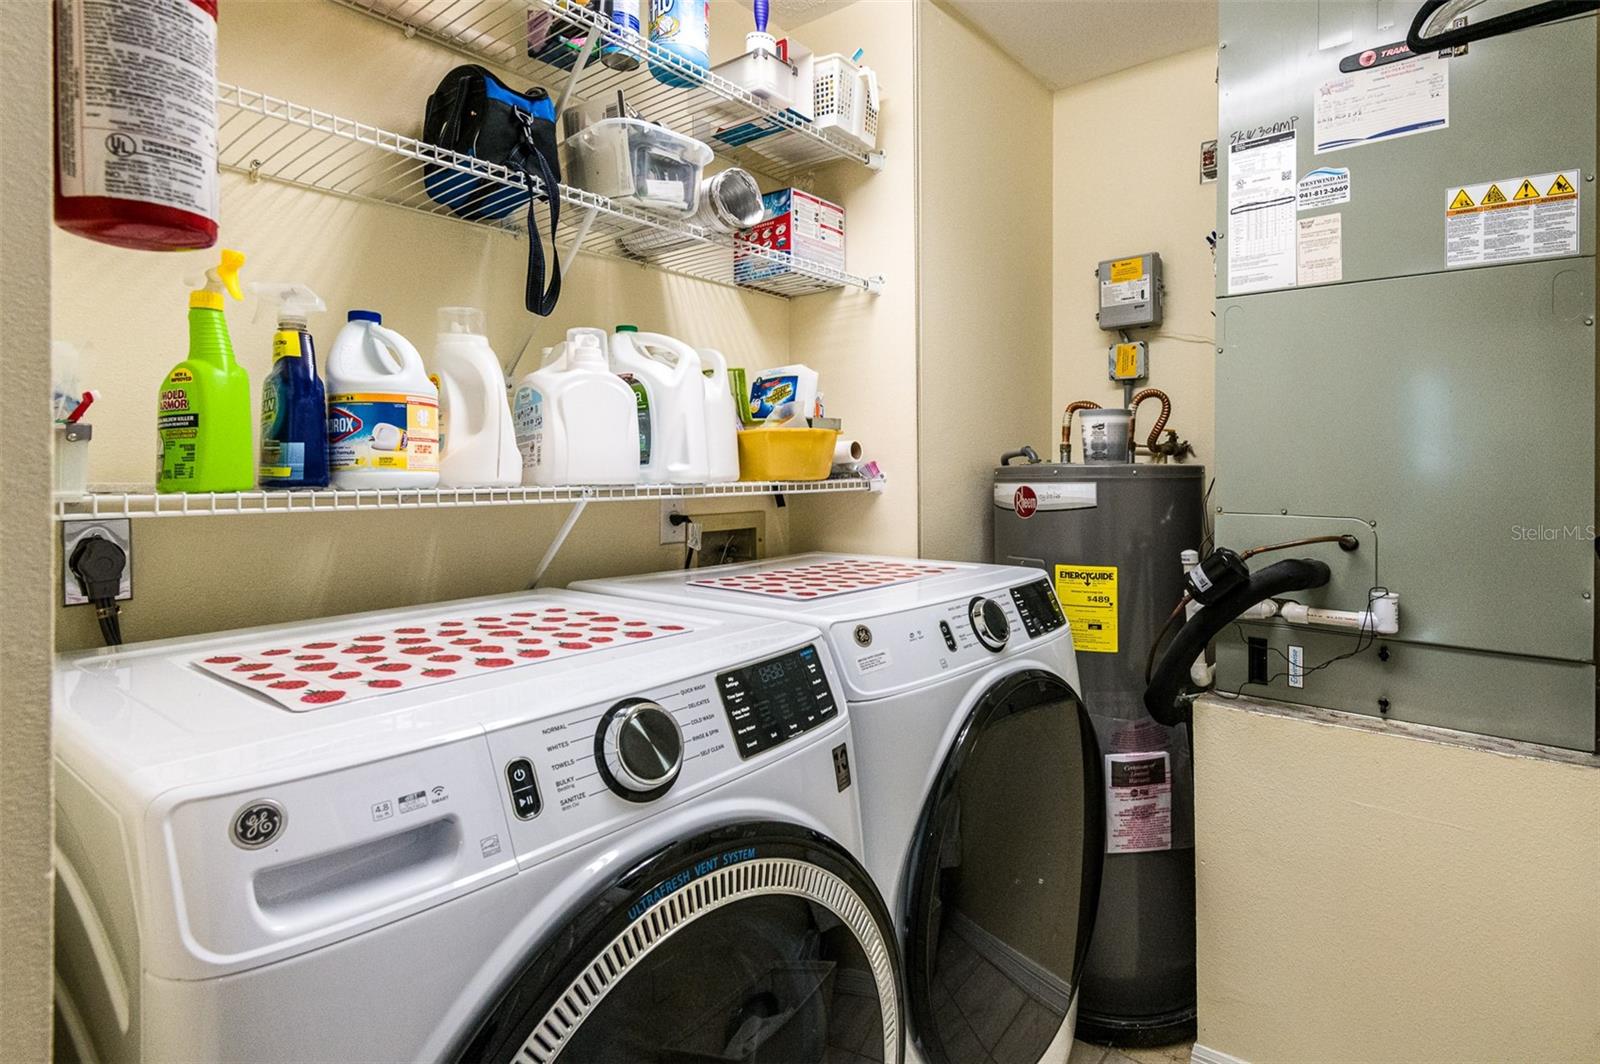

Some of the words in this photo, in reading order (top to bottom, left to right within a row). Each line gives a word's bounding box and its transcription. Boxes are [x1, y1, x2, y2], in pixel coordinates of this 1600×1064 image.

[1299, 175, 1334, 188] WESTWIND
[1298, 184, 1349, 200] 941-812-3669
[1087, 595, 1110, 604] $489
[688, 698, 710, 710] DELICATES
[542, 722, 567, 736] NORMAL
[546, 740, 570, 753] WHITES
[551, 758, 576, 771] TOWELS
[556, 776, 575, 788] BULKY
[560, 792, 586, 806] SANITIZE
[375, 802, 390, 814] 4.8
[627, 870, 691, 921] ULTRAFRESH
[694, 856, 719, 878] VENT
[722, 848, 758, 865] SYSTEM
